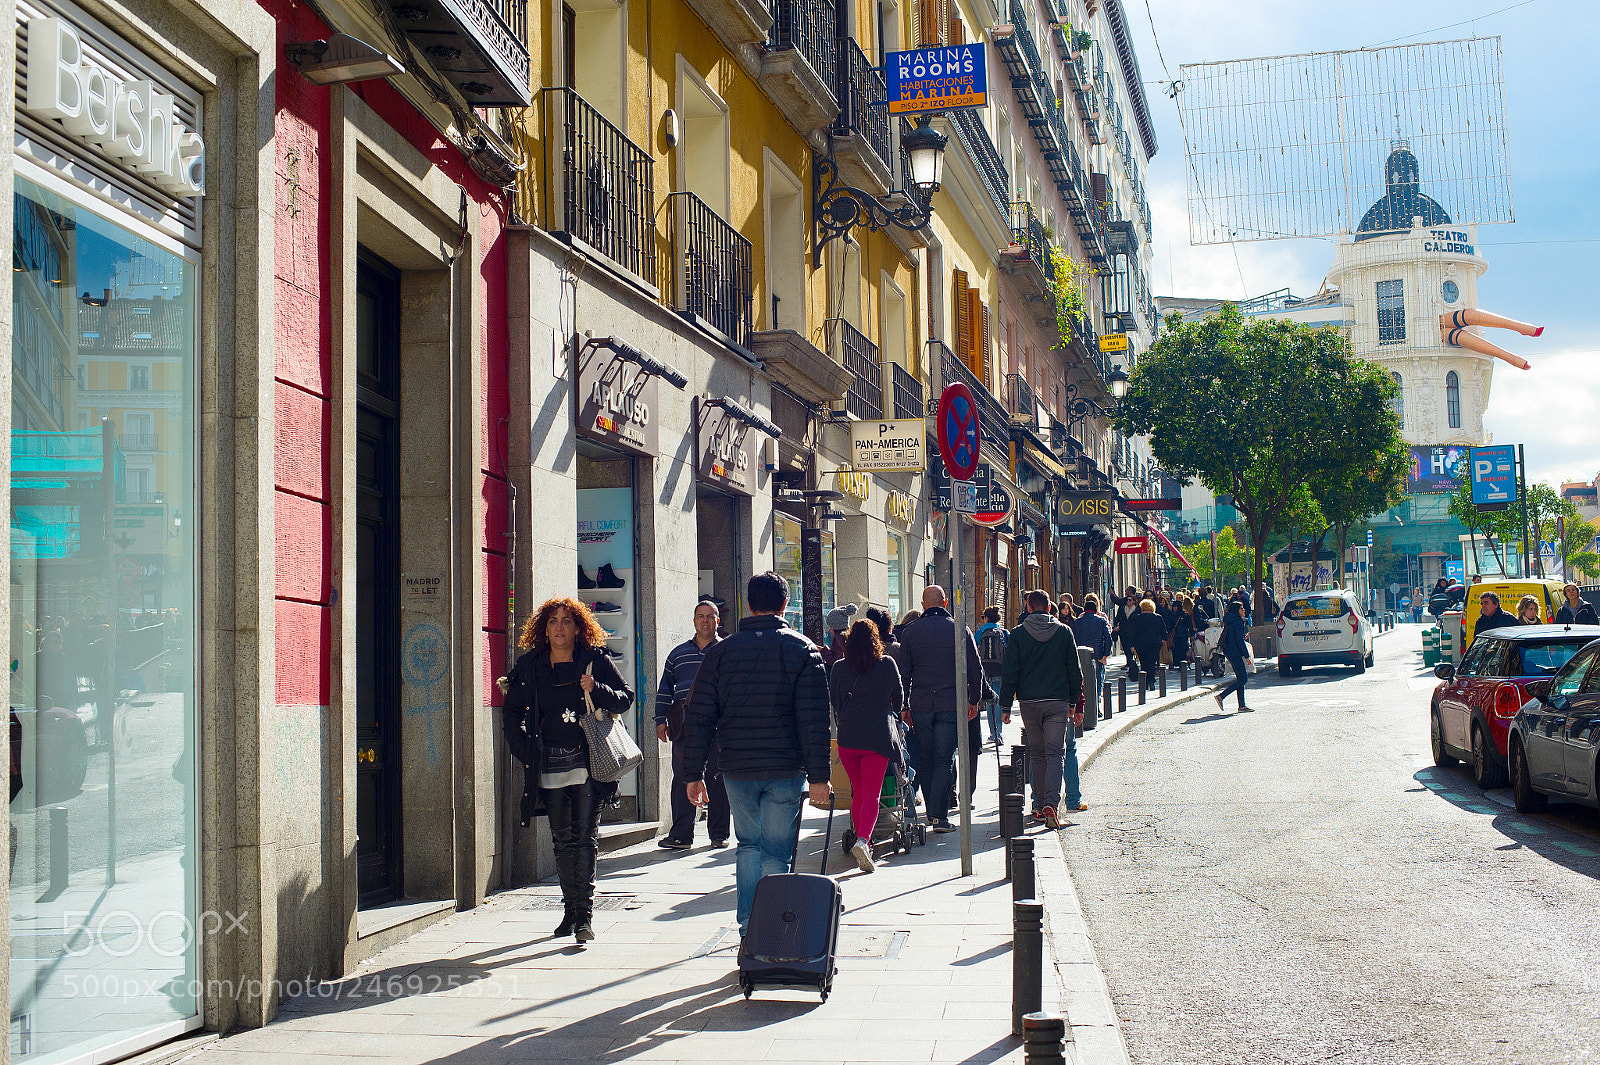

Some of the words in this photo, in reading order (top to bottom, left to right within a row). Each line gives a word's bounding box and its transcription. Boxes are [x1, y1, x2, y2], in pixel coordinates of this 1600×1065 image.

[898, 47, 973, 66] MARINA
[899, 60, 974, 79] ROOMS
[899, 75, 974, 91] HABITACIONES
[900, 84, 975, 101] MARINA
[27, 17, 205, 197] Bershka
[901, 101, 918, 110] PISO
[947, 97, 974, 106] FLOOR
[1430, 230, 1468, 243] TEATRO
[1424, 241, 1475, 256] CALDERON
[591, 380, 650, 425] APLAUSO
[855, 437, 920, 450] PAN-AMERICA
[1430, 447, 1444, 455] THE
[708, 435, 749, 471] APLAUSO
[1474, 460, 1493, 483] P
[1060, 499, 1109, 516] OASIS
[596, 520, 627, 530] COMFORT
